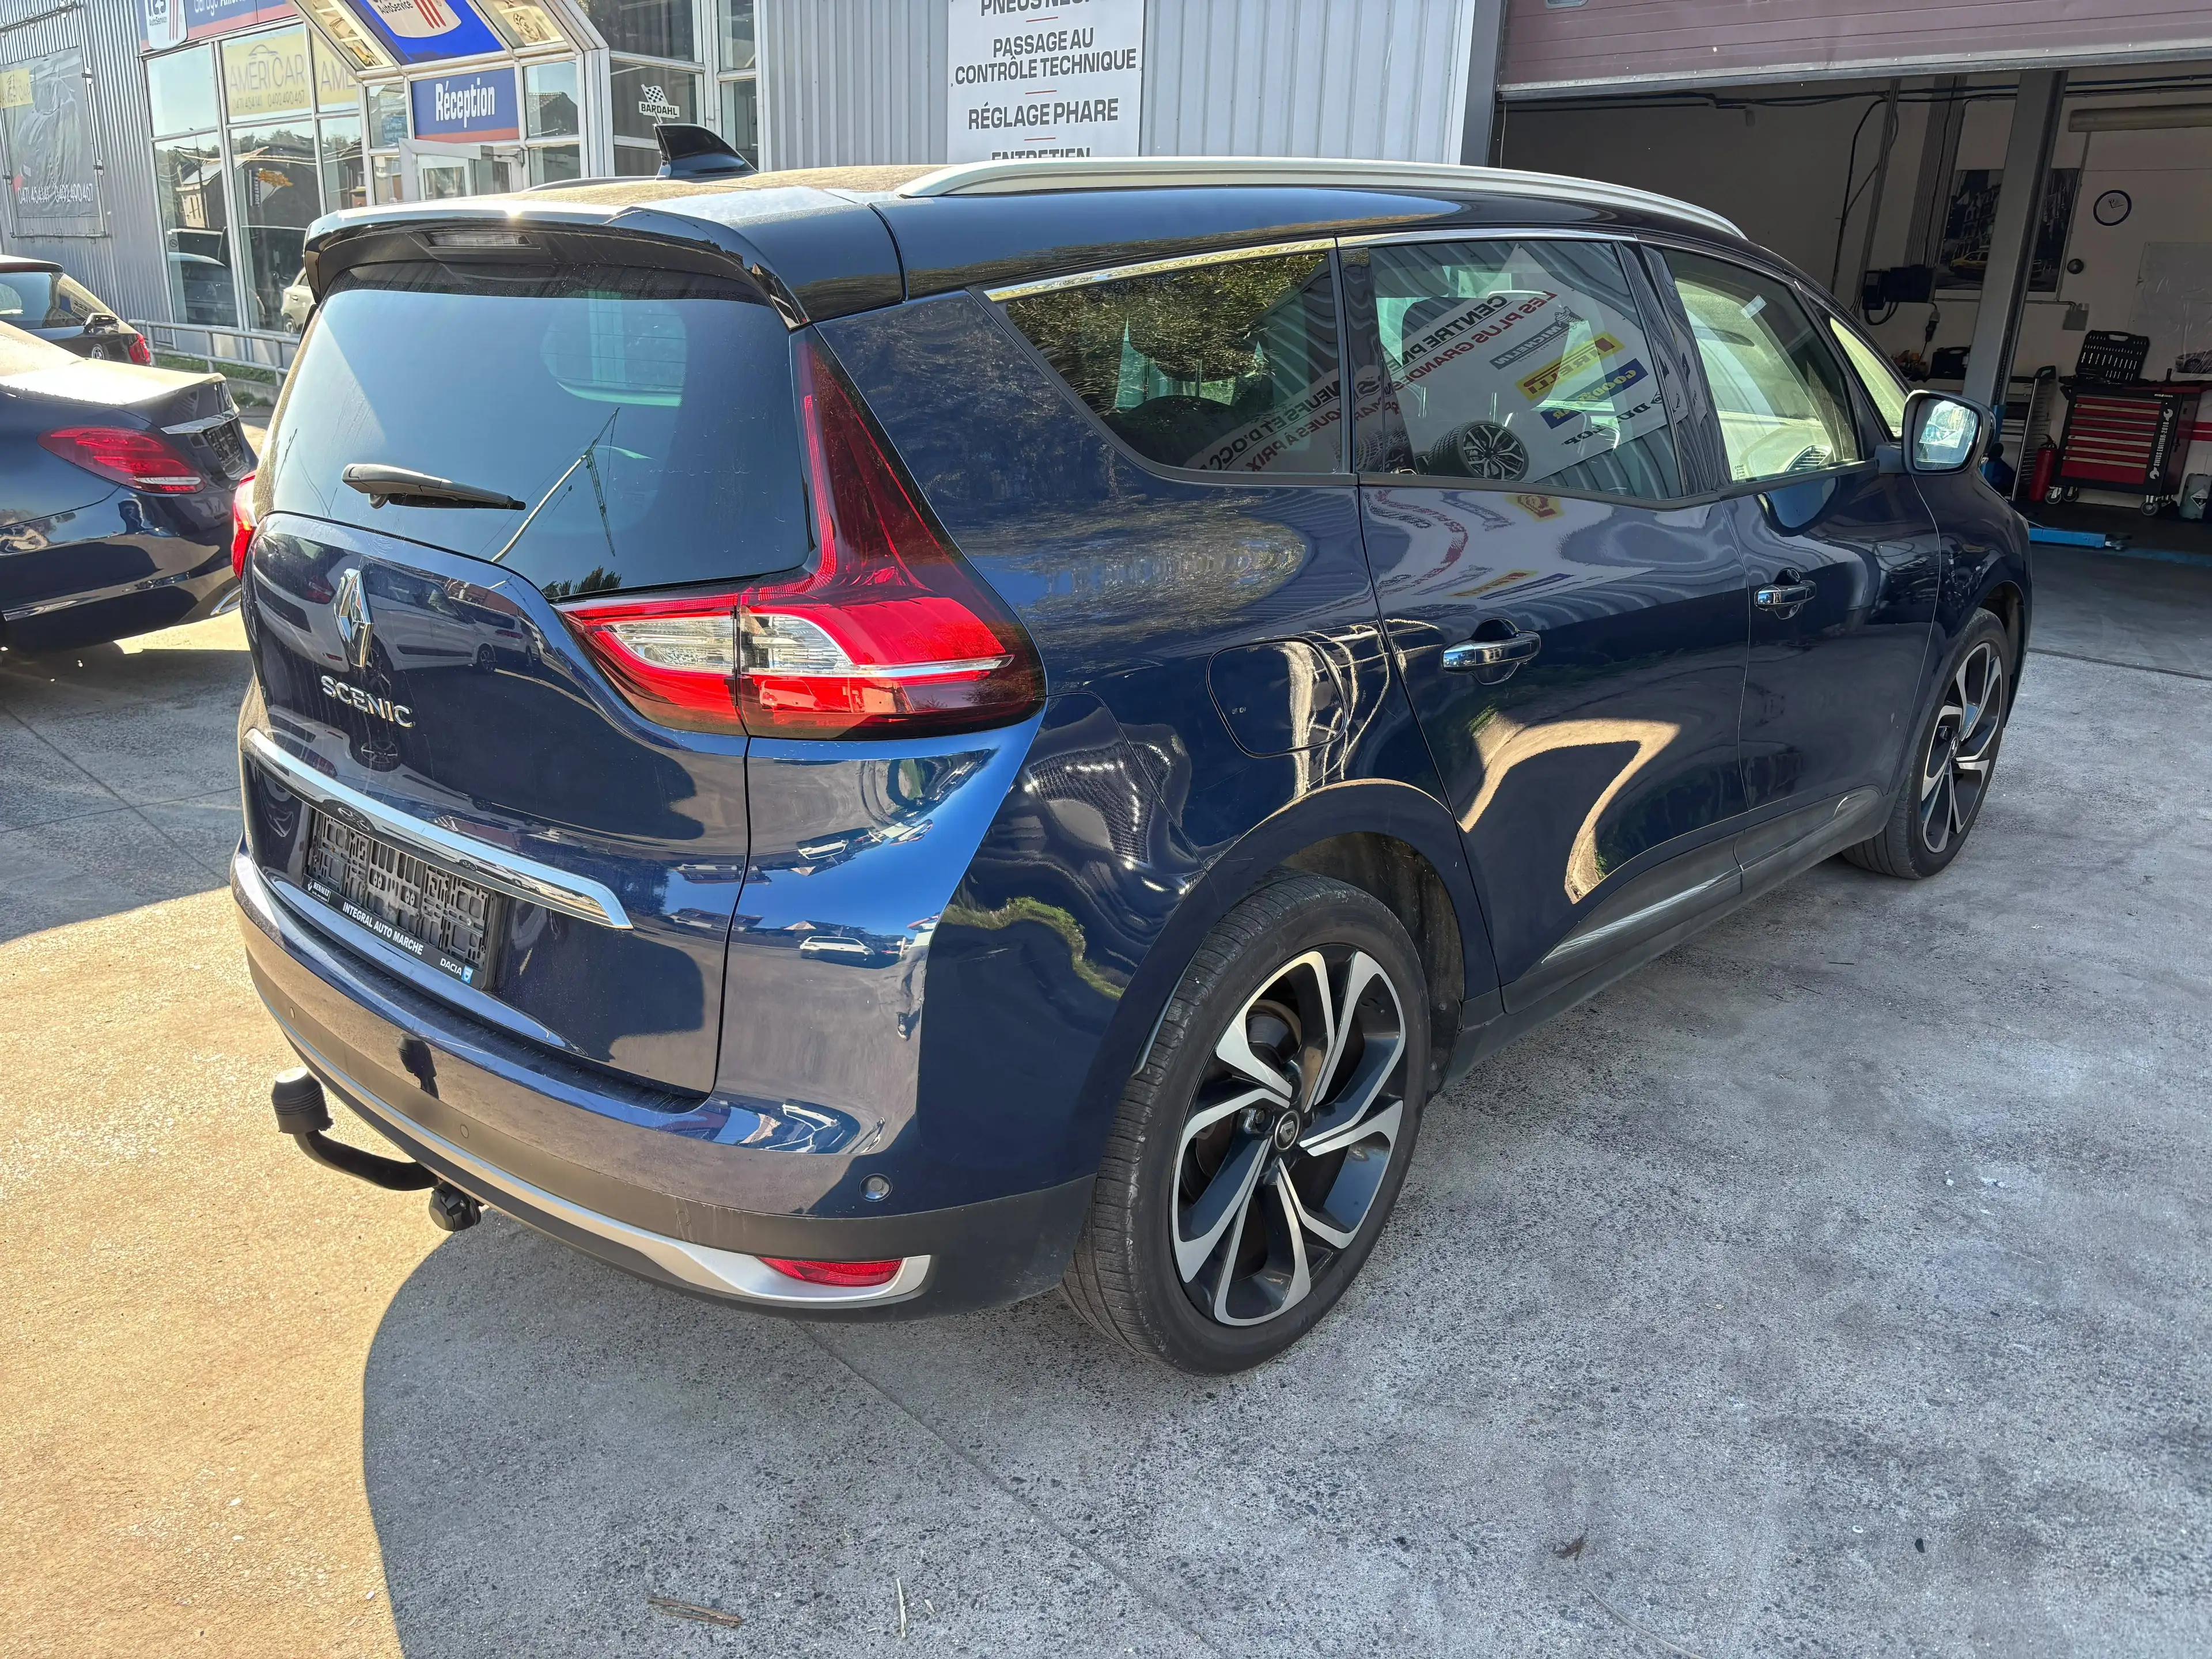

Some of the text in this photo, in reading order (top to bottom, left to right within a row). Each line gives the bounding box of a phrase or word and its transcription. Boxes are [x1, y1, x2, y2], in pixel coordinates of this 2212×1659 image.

[377, 1, 414, 14] AutoService
[993, 27, 1094, 58] PASSAGE AU
[229, 54, 305, 94] AMERICAR
[955, 48, 1137, 85] CONTRÔLE TECHNIQUE
[435, 77, 495, 128] Réception
[641, 104, 677, 115] BARDAHL
[968, 98, 1119, 130] RÉGLAGE PHARE
[321, 675, 416, 728] SCENIC
[313, 882, 331, 897] RENAULT
[343, 902, 424, 955] INTEGRAL AUTO MARCHE
[440, 957, 463, 976] DACIA
